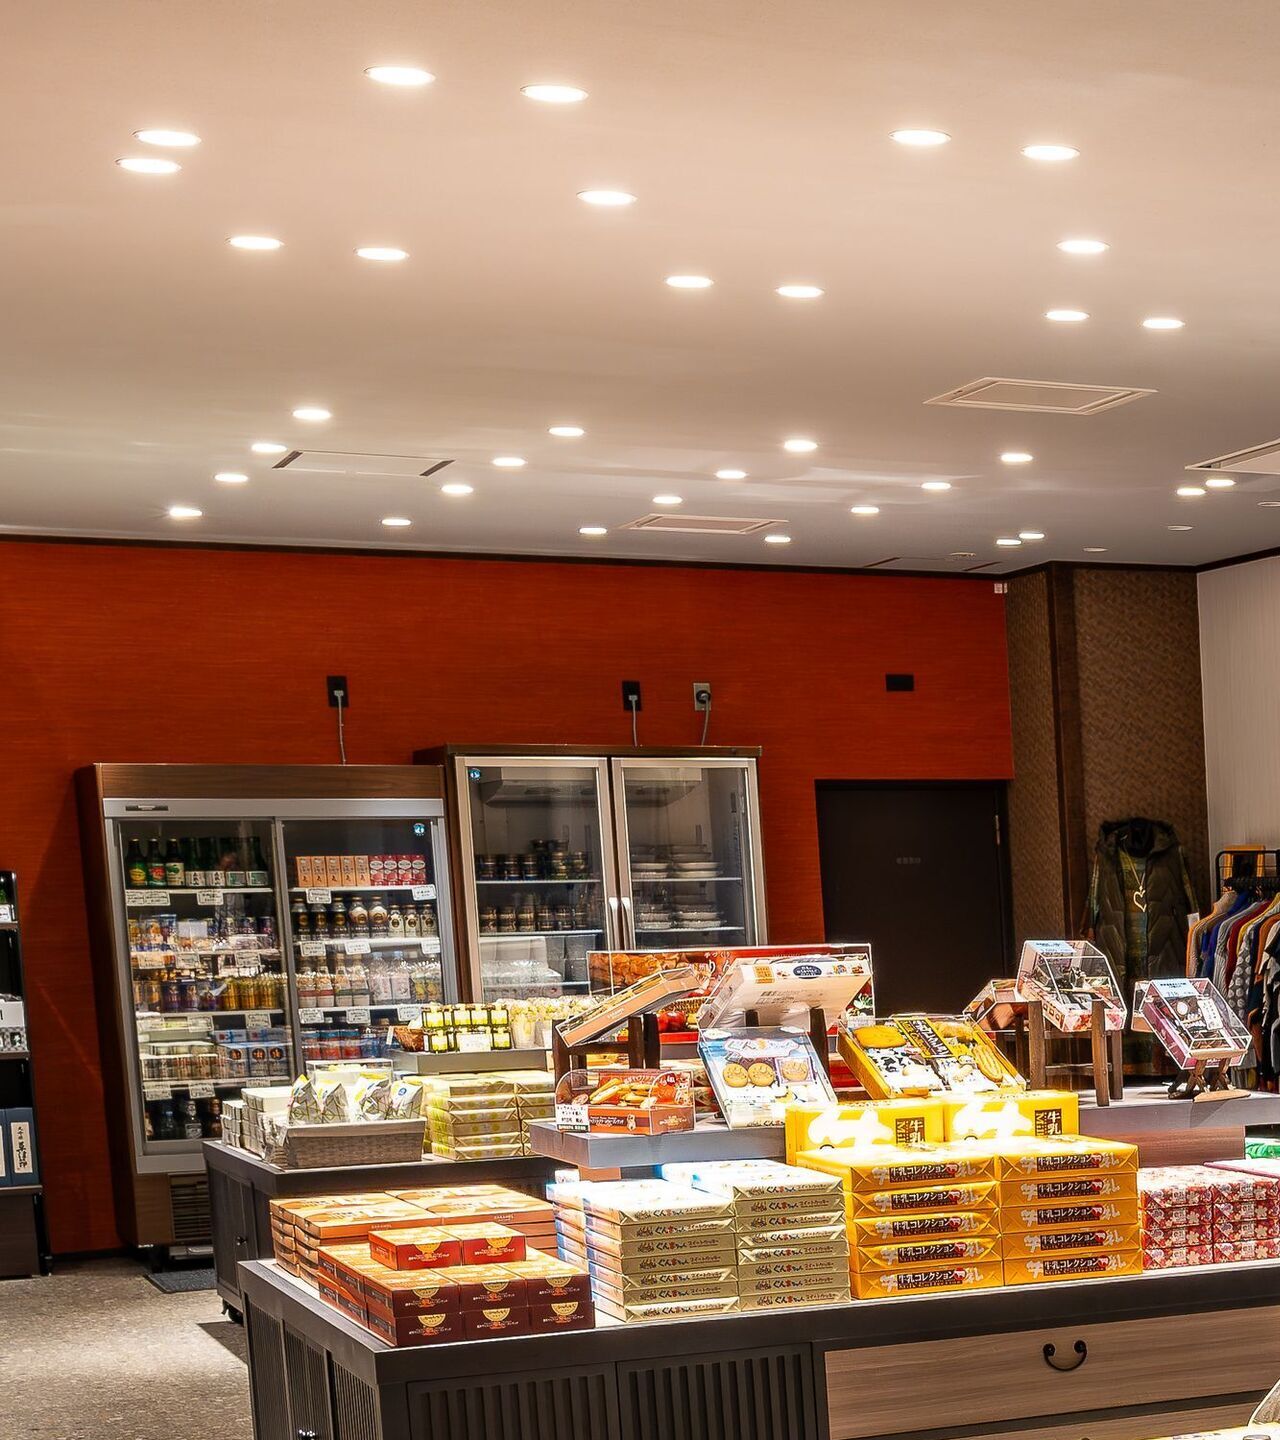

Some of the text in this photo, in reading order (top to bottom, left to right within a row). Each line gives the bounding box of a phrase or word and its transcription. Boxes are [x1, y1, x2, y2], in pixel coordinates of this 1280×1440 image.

[1047, 1112, 1061, 1135] 牛乳
[1038, 1154, 1093, 1166] 牛乳コレクション
[891, 1164, 948, 1176] 牛乳コレクション
[893, 1191, 949, 1203] 牛乳コレクション
[1042, 1231, 1096, 1244] 牛乳コレクション
[1044, 1257, 1099, 1270] 牛乳コレクション
[899, 1271, 955, 1283] 牛乳コレクション
